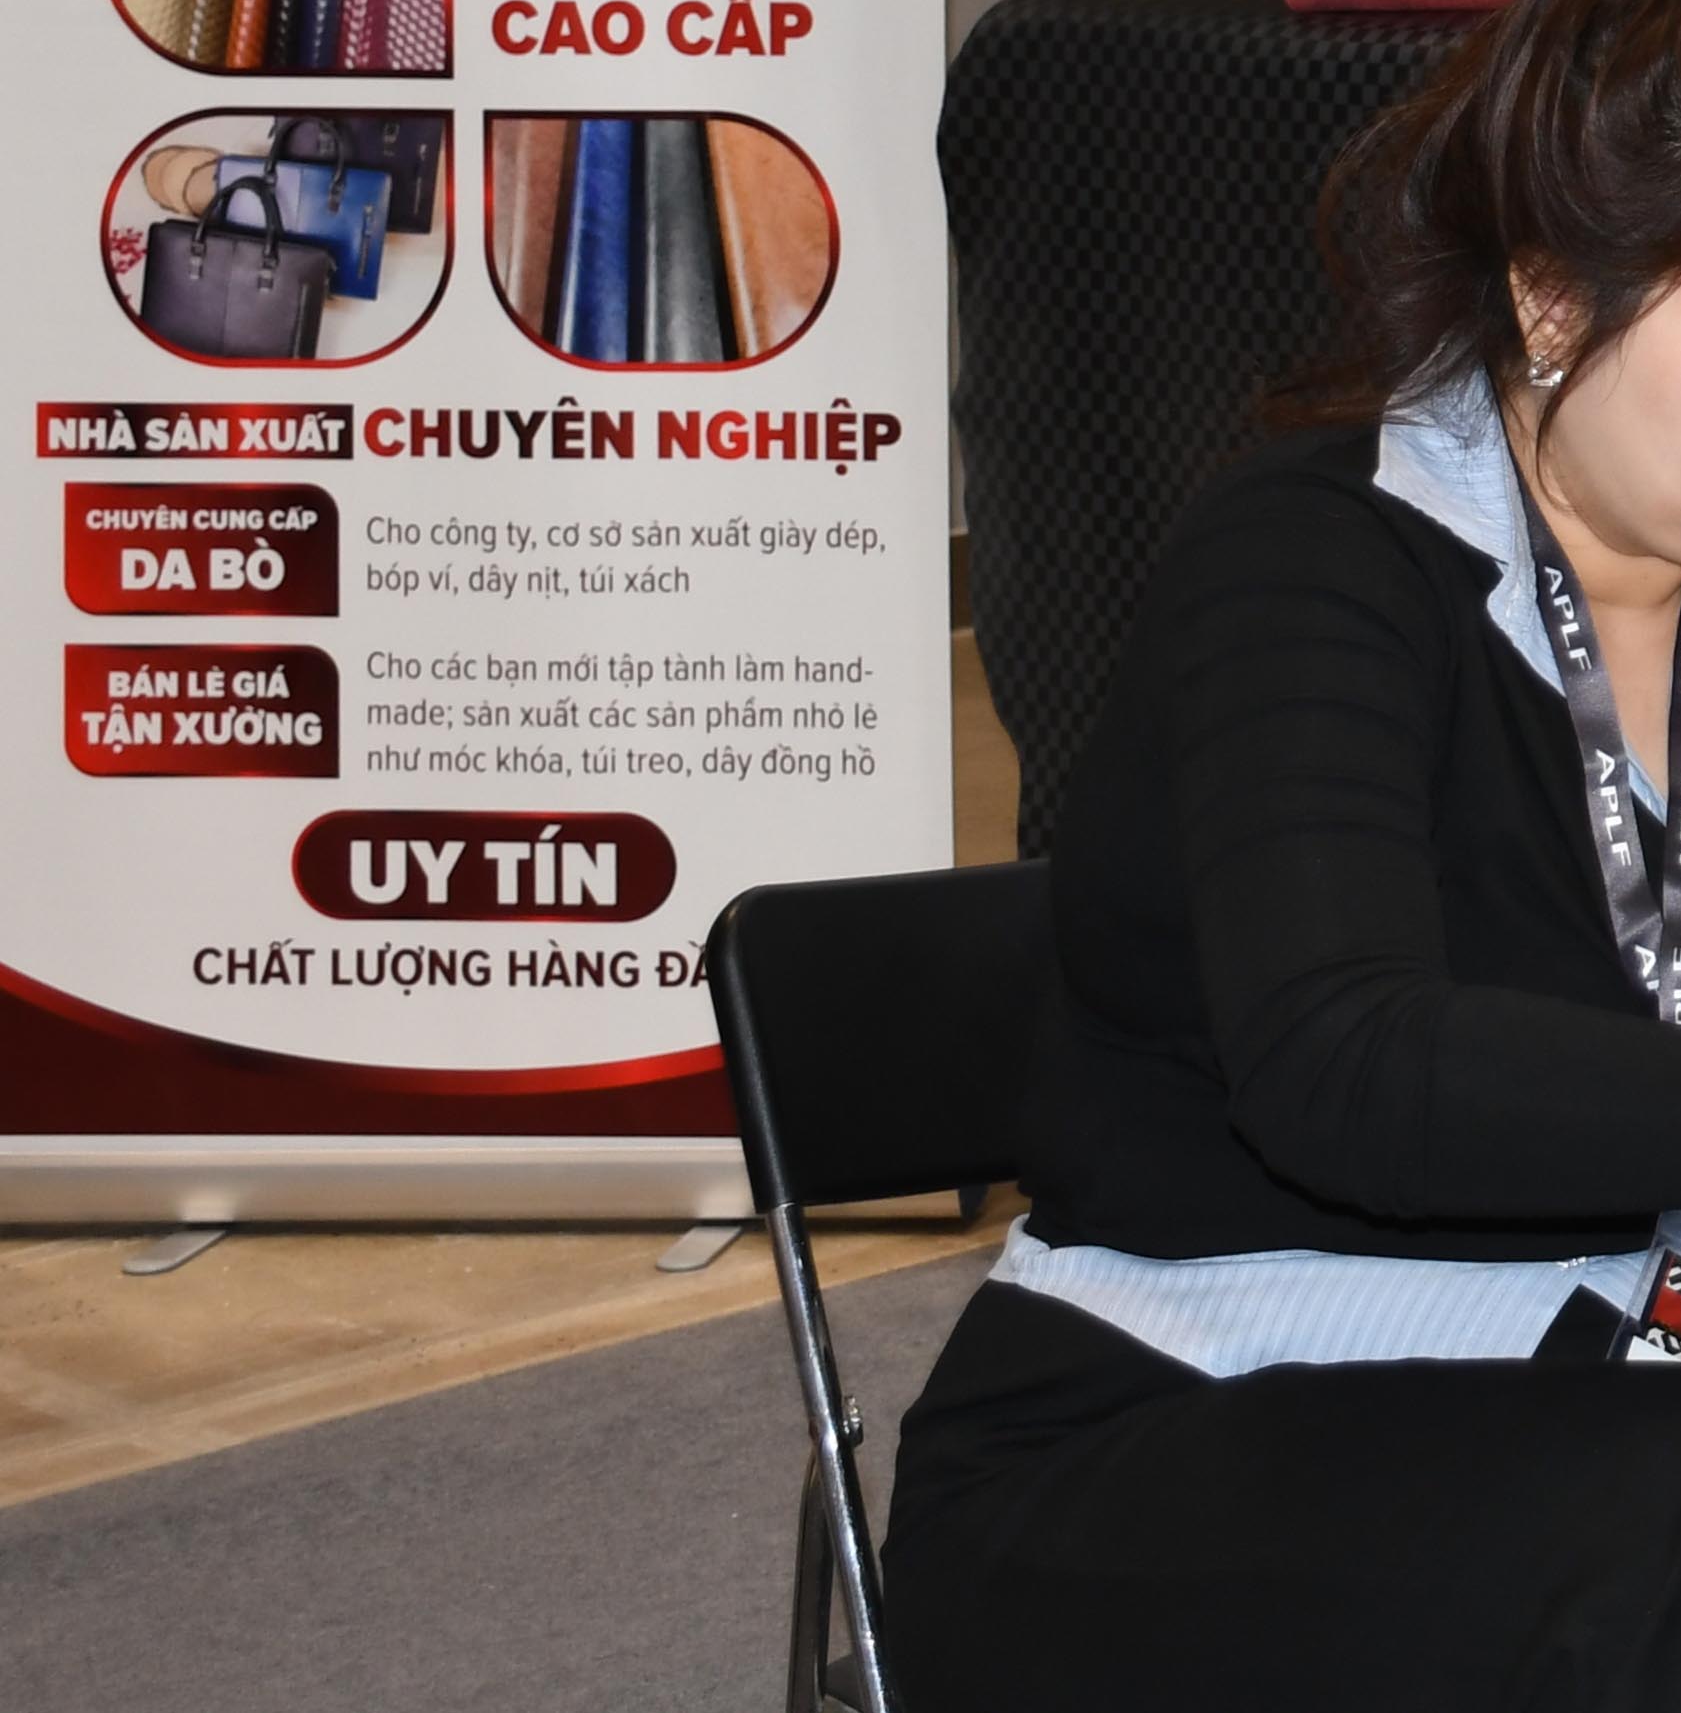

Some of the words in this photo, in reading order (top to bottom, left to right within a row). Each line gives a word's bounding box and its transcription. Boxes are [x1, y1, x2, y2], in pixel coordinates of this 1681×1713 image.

[48, 410, 135, 451] NHÀ
[145, 413, 229, 452] SẢN
[239, 410, 345, 452] XUẤT
[364, 396, 634, 459] CHUYÊN
[658, 398, 901, 475] NGHIỆP
[86, 504, 188, 530] CHUYÊN
[193, 510, 263, 530] CUNG
[269, 505, 318, 530] CẤP
[366, 515, 421, 546] Cho
[429, 516, 497, 555] công
[506, 520, 537, 555] ty,
[546, 521, 580, 548] cơ
[631, 519, 681, 548] sản
[691, 515, 751, 549] xuất
[759, 518, 818, 557] giày
[825, 519, 886, 556] dép,
[121, 549, 196, 590] DA
[209, 538, 286, 590] BÒ
[366, 561, 420, 599] bóp
[428, 563, 459, 597] ví,
[468, 562, 519, 601] dây
[527, 565, 570, 601] nịt,
[579, 563, 614, 594] túi
[624, 564, 690, 594] xách
[1542, 565, 1592, 673] APLF
[108, 665, 178, 698] BÁN
[233, 665, 289, 698] GIÁ
[366, 650, 422, 681] Cho
[430, 650, 477, 682] các
[486, 652, 538, 688] bạn
[547, 653, 598, 683] mới
[607, 652, 654, 689] tập
[663, 651, 725, 683] tành
[735, 653, 785, 683] làm
[794, 654, 873, 684] hand-
[82, 703, 163, 754] TẬN
[173, 706, 323, 746] XƯỞNG
[367, 698, 454, 731] made;
[462, 699, 510, 728] sản
[519, 695, 580, 729] xuất
[588, 698, 637, 729] các
[646, 700, 695, 729] sản
[705, 695, 783, 735] phẩm
[793, 700, 845, 730] nhỏ
[854, 701, 878, 730] lẻ
[367, 744, 422, 773] như
[428, 743, 487, 774] móc
[495, 744, 572, 779] khóa,
[581, 745, 616, 775] túi
[626, 748, 692, 778] treo,
[701, 744, 753, 782] dây
[760, 742, 831, 783] đồng
[841, 743, 876, 776] hồ
[1595, 747, 1632, 867] APLF
[350, 841, 465, 905] UY
[485, 825, 618, 907] TÍN
[192, 938, 316, 986] CHẤT
[331, 941, 492, 994] LƯỢNG
[508, 939, 640, 989] HÀNG
